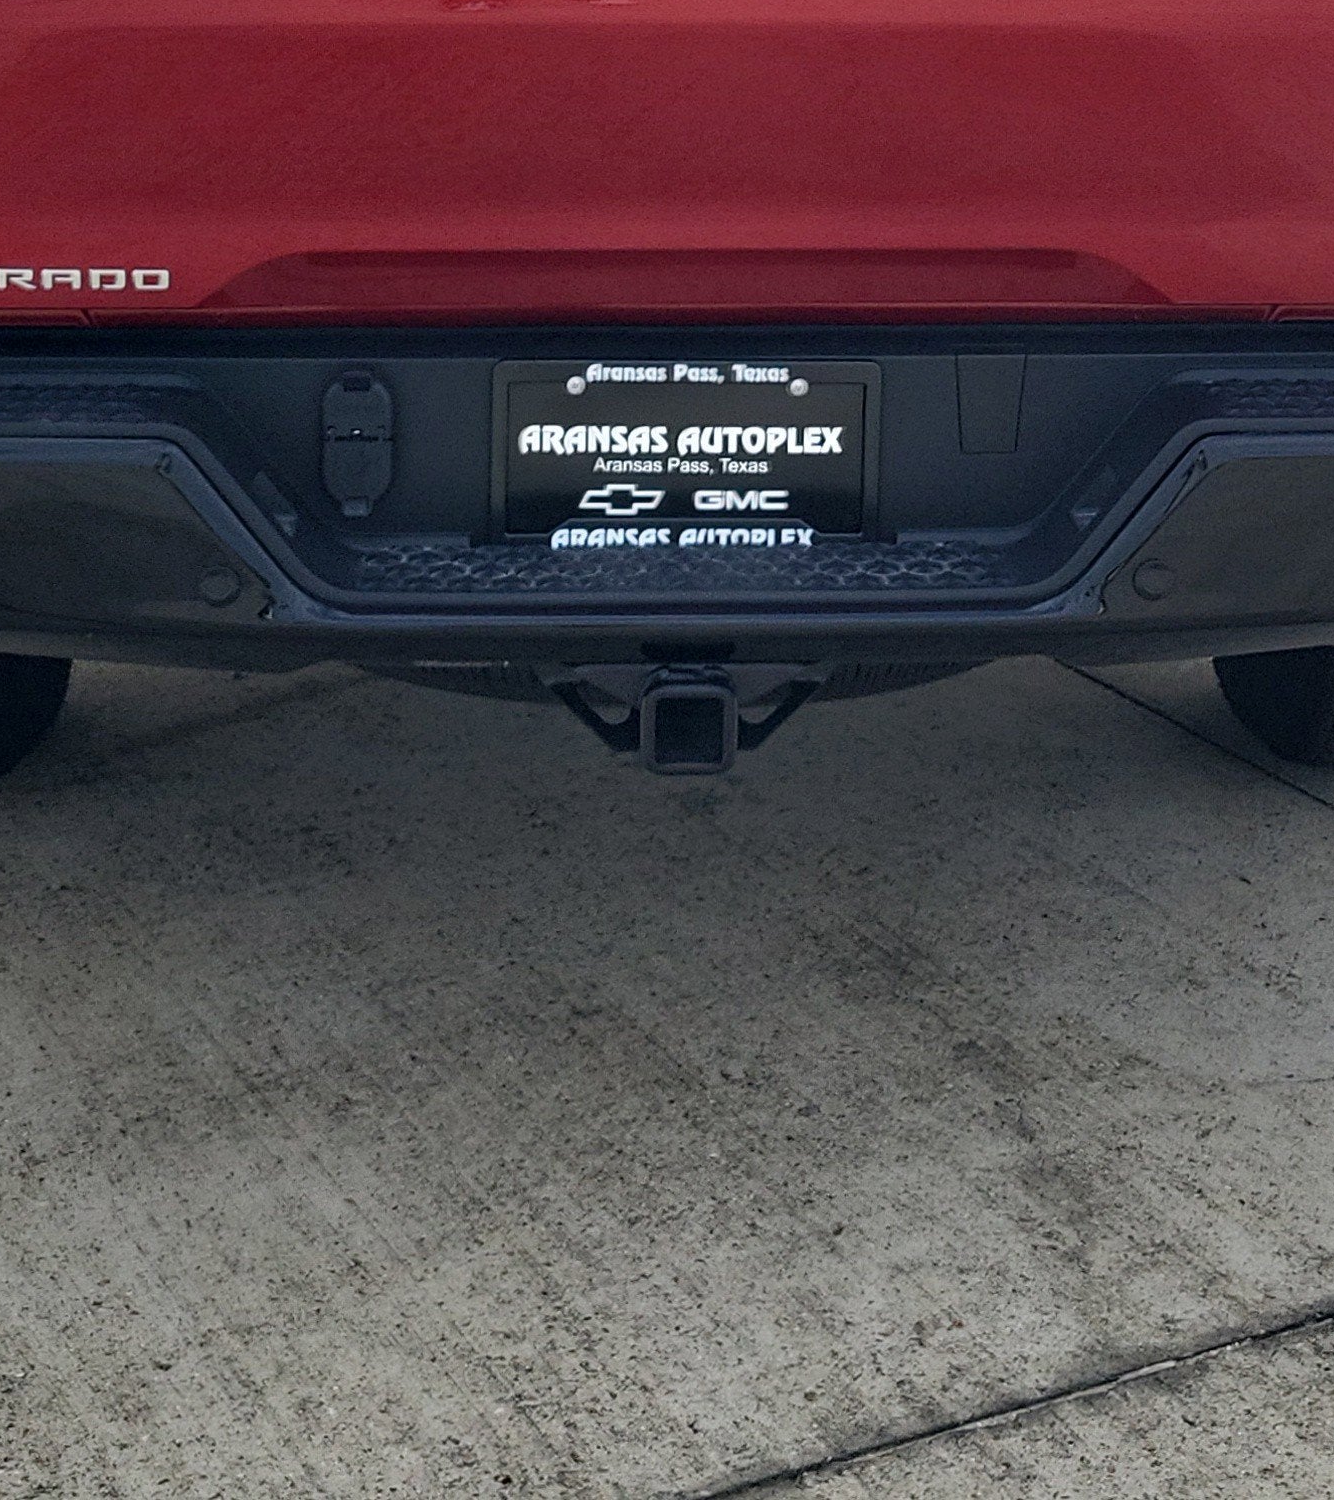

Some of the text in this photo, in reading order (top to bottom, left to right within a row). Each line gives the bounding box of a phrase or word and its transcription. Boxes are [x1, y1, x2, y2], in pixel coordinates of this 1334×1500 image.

[586, 363, 789, 385] Aransas Pass, Texas
[519, 424, 843, 456] ARANSAS AUTOPLEX
[593, 457, 769, 475] Aransas Pass, Texas
[693, 490, 790, 511] GMC
[551, 528, 671, 550] ARANSAS
